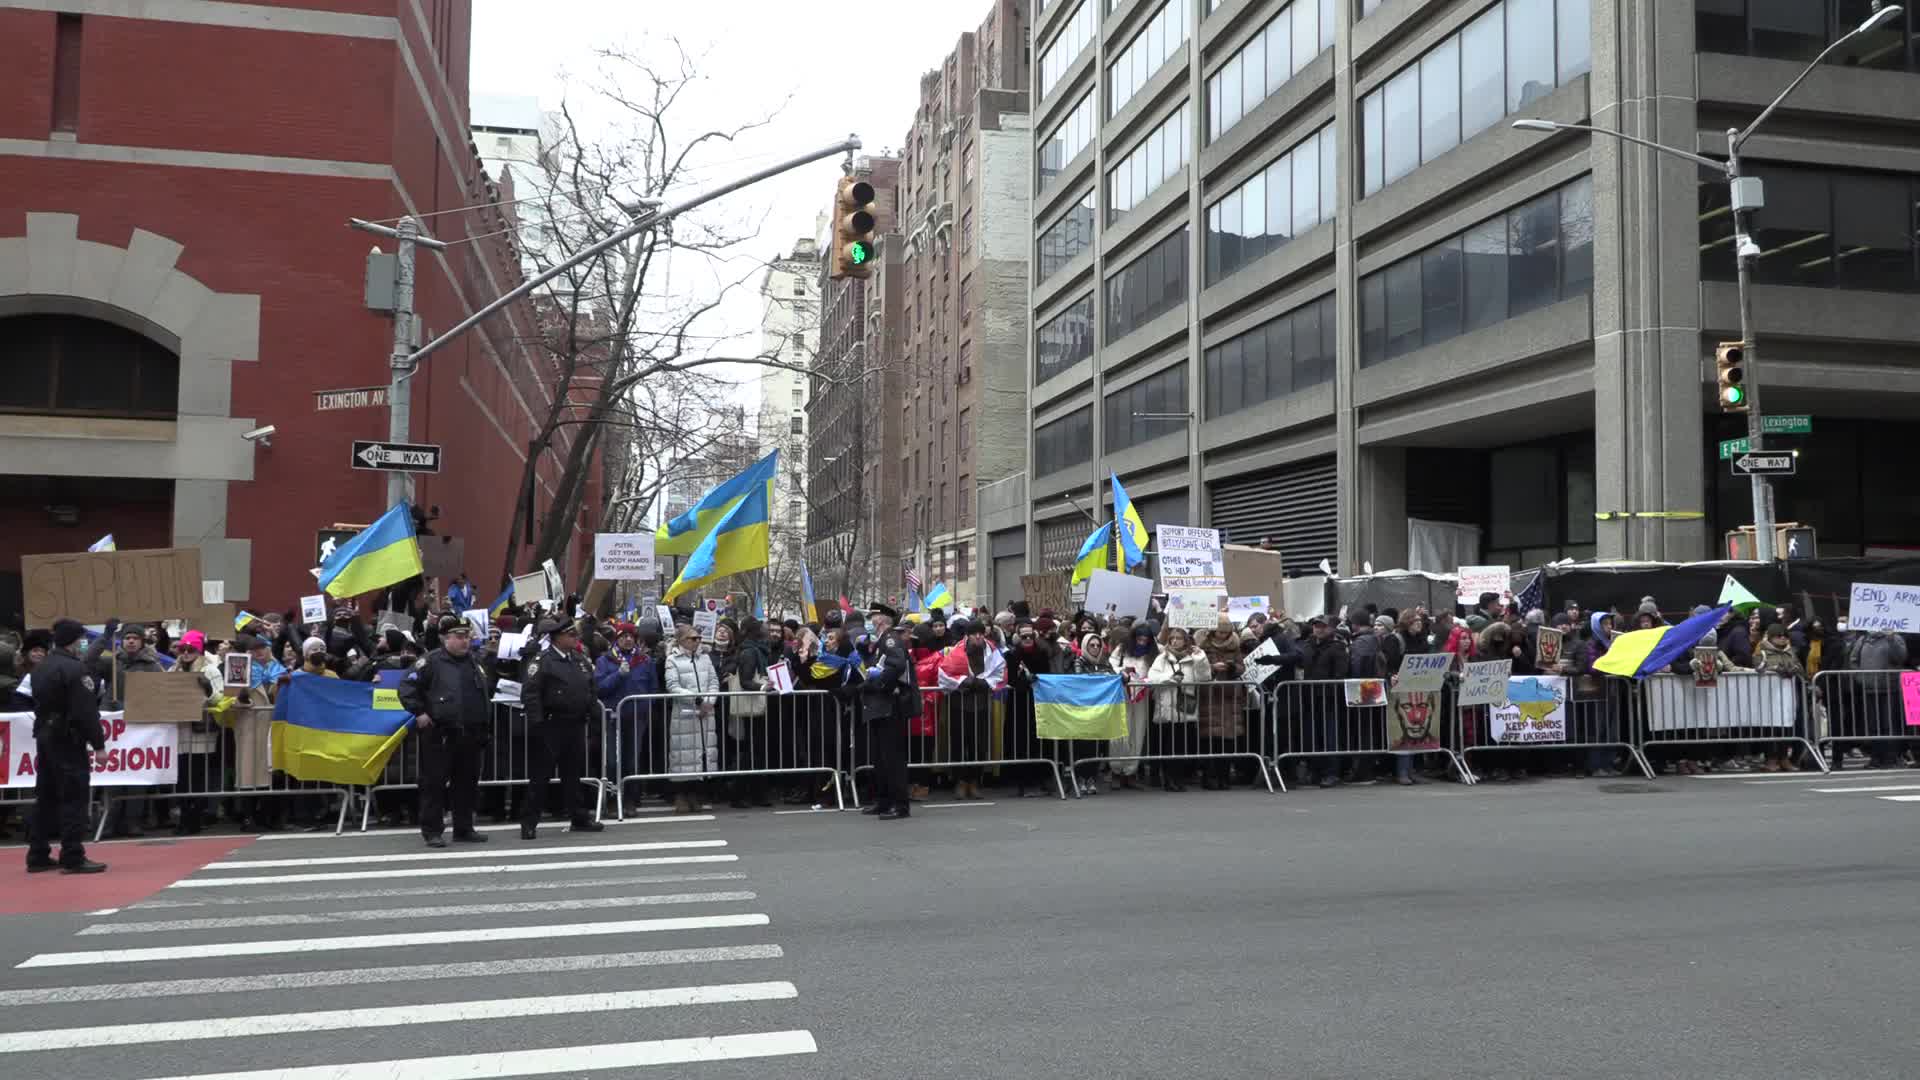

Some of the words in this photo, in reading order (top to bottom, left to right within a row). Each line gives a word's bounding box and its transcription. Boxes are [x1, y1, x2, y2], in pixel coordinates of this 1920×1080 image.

[318, 391, 368, 410] LEXINGTON
[372, 390, 384, 405] AV
[1763, 416, 1809, 428] Lexington
[1723, 442, 1729, 457] E
[366, 450, 392, 462] ONE
[402, 451, 429, 465] WAY
[1742, 458, 1760, 468] ONE
[1767, 457, 1787, 468] WAY
[1161, 527, 1185, 536] SUPPORT
[1187, 528, 1213, 538] DEFENSE
[1162, 555, 1182, 565] OTHER
[1184, 557, 1202, 566] WAYS
[1163, 566, 1173, 574] TO
[1175, 566, 1191, 575] HELP
[1020, 575, 1064, 592] PUTIN
[1853, 586, 1888, 602] SEND
[1873, 603, 1889, 613] TO
[1852, 616, 1910, 630] UKRAINE
[1407, 655, 1447, 670] STAND
[1466, 686, 1488, 697] WAR
[1495, 712, 1520, 721] PUTIN
[1505, 721, 1528, 731] KEEP
[1531, 720, 1562, 731] HANDS
[1502, 732, 1520, 740] OFF
[1523, 730, 1563, 740] UKRAINE!
